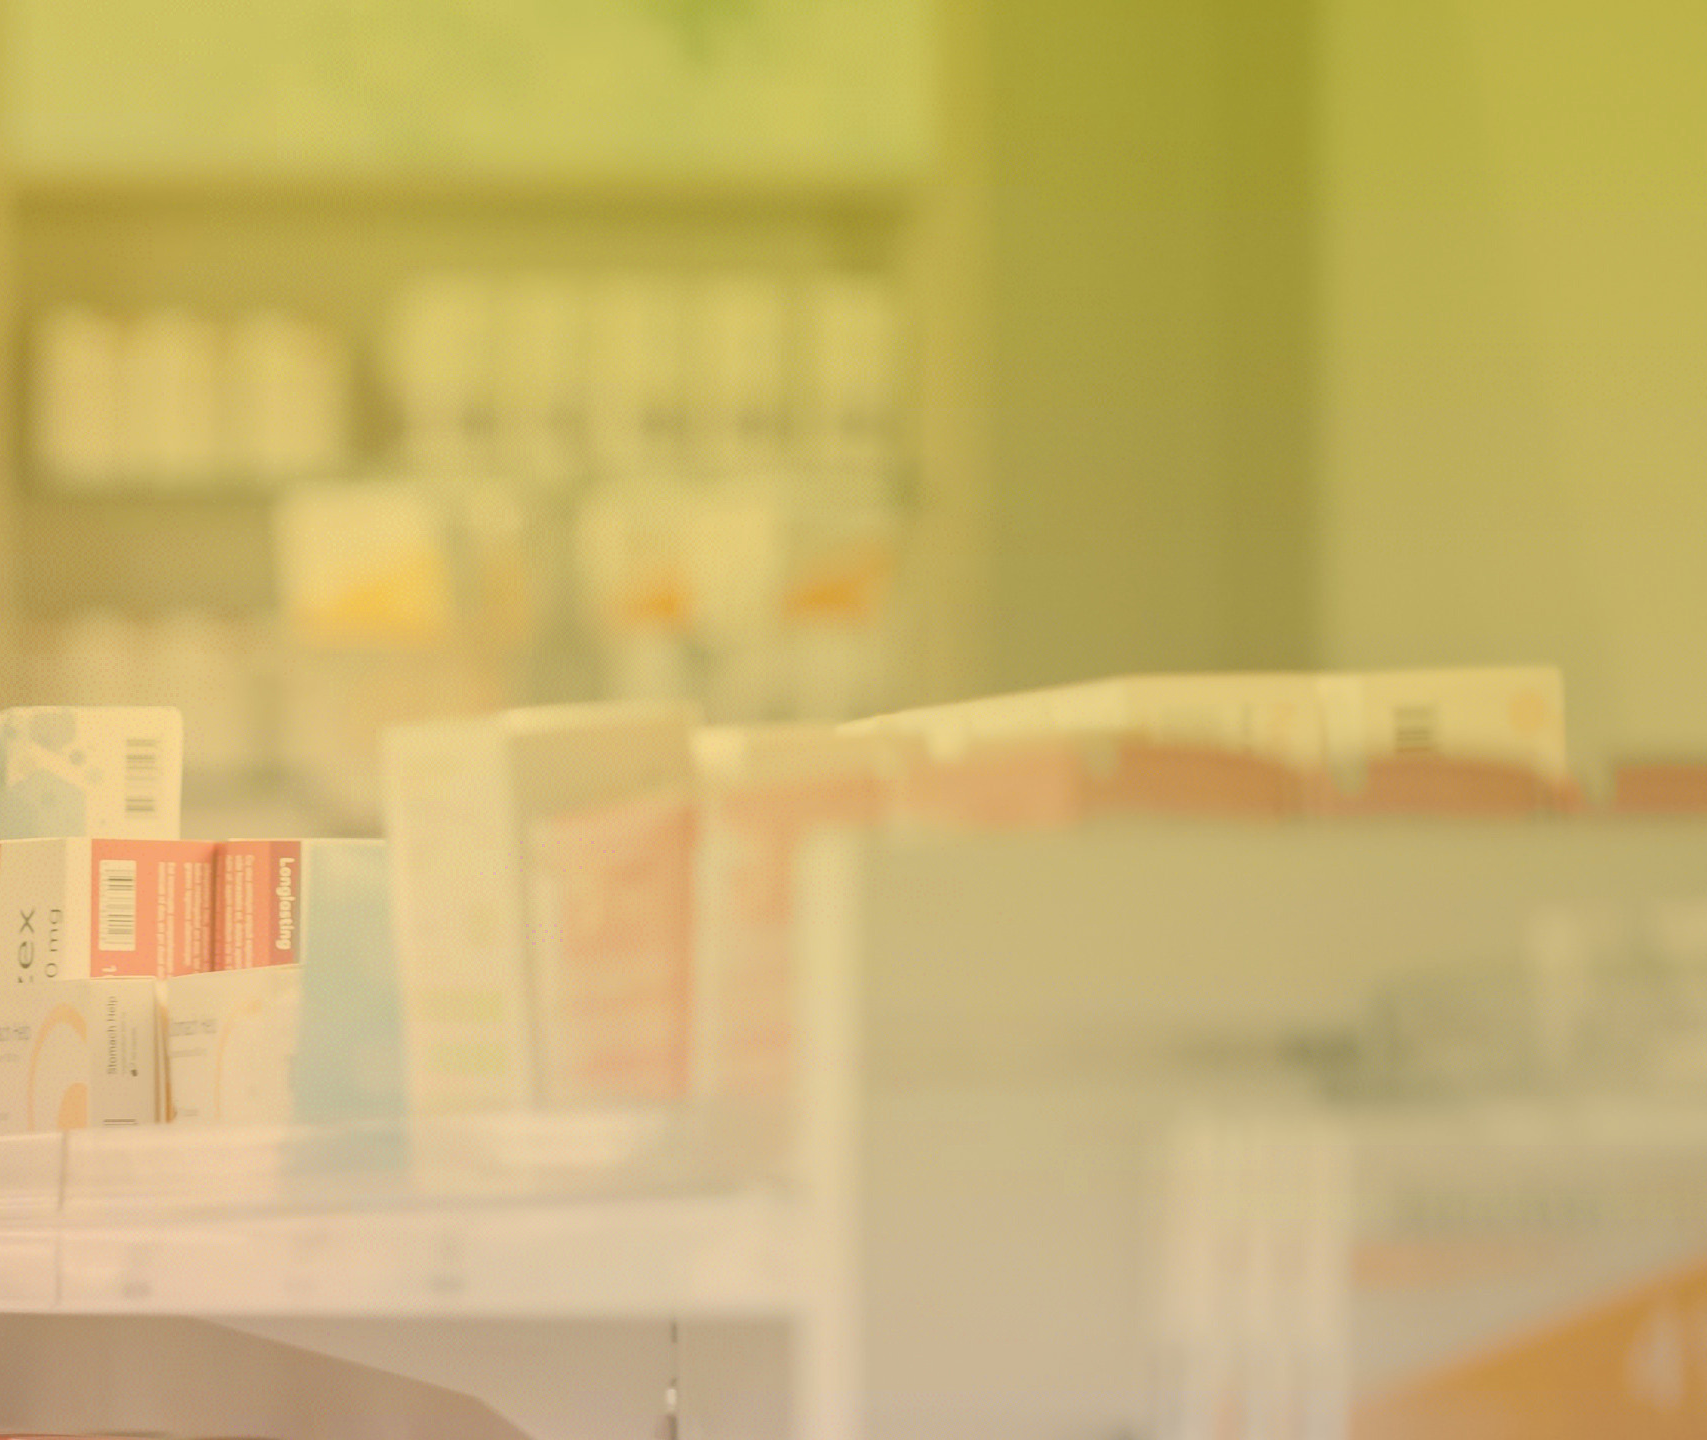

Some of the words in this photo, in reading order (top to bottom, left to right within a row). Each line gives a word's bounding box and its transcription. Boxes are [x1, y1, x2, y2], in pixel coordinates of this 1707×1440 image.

[275, 857, 295, 950] Longlasting
[106, 996, 119, 1023] Help
[106, 1025, 118, 1075] Stomach
